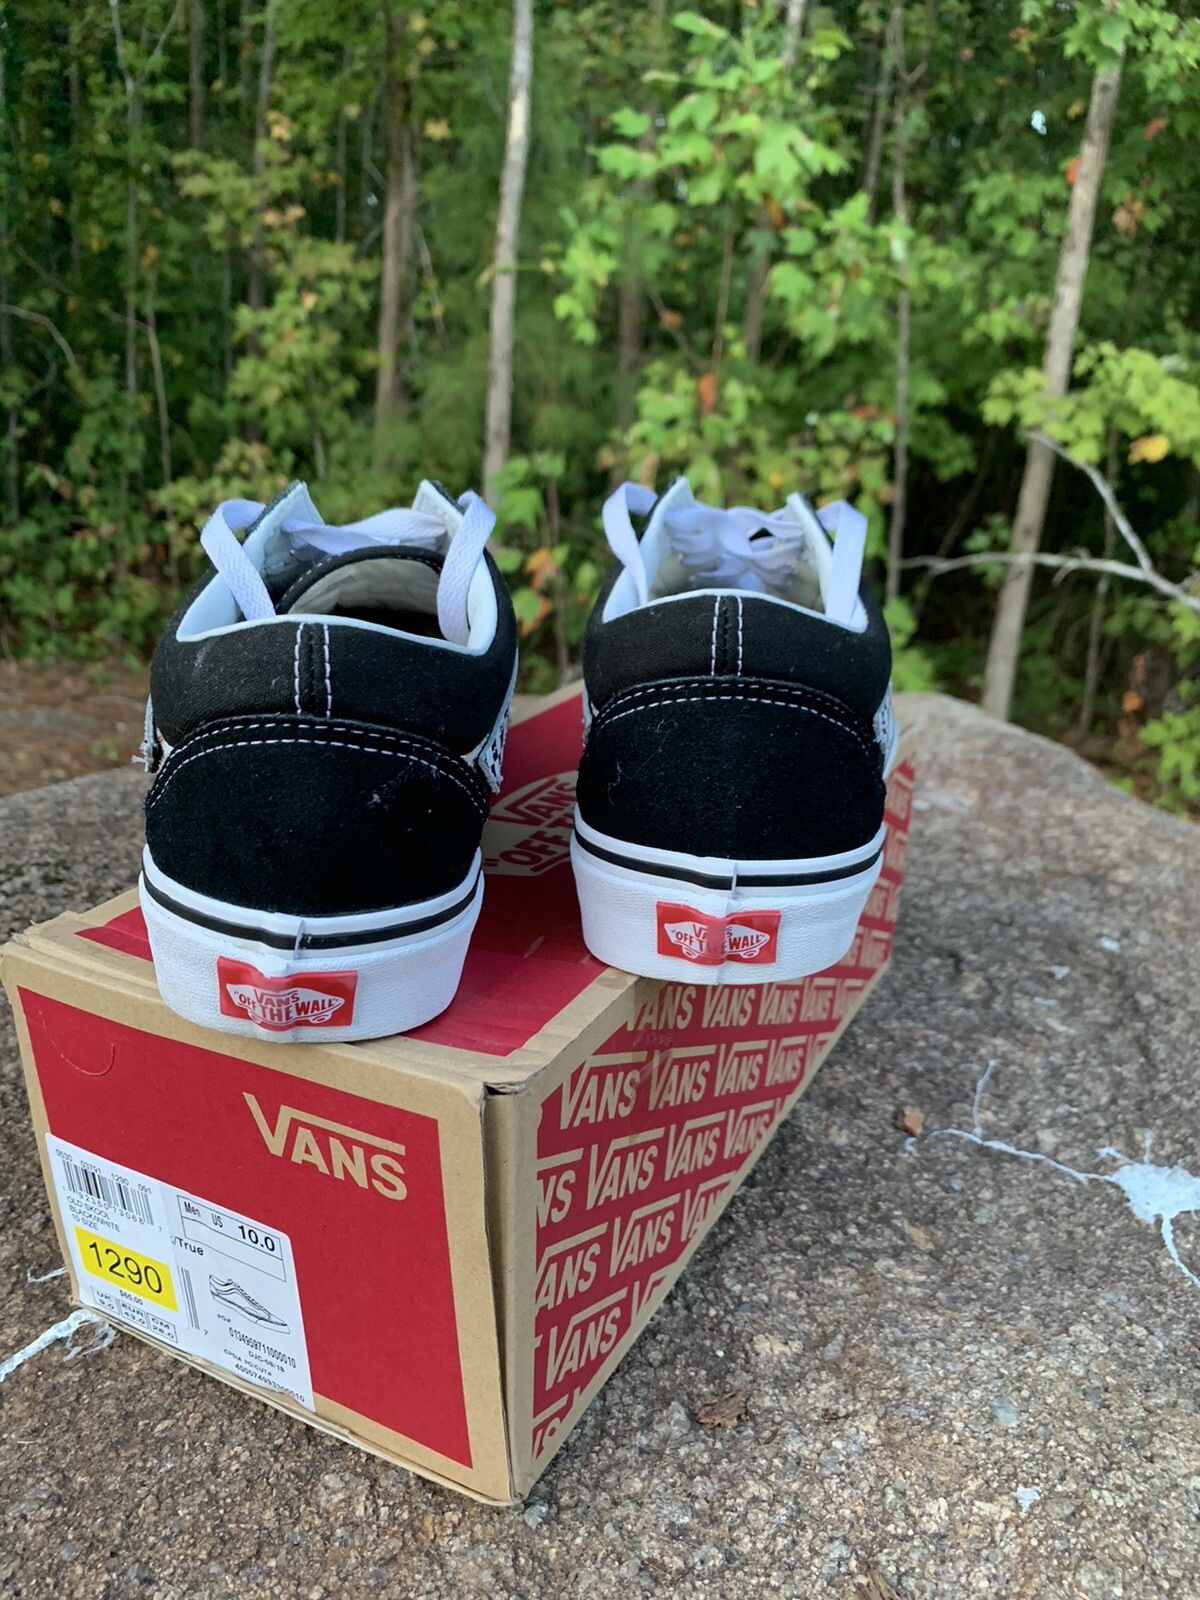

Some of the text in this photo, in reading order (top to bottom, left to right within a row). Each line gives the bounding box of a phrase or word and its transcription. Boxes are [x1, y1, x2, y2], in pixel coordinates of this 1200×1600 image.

[692, 924, 733, 940] VAS
[254, 989, 300, 1008] VANS
[260, 1004, 294, 1022] THE
[702, 984, 756, 1028] VANS
[560, 1051, 648, 1130] VANS
[648, 1044, 716, 1111] VANS
[714, 1039, 769, 1097] VANS
[765, 1034, 809, 1087] VANS
[242, 1092, 408, 1200] VANS
[586, 1127, 665, 1210] VANS
[664, 1111, 726, 1181] VANS
[722, 1099, 775, 1159] VANS
[67, 1195, 110, 1220] OLD SKOOL
[81, 1218, 99, 1231] SIZE
[184, 1201, 276, 1253] Men US 10.0
[609, 1193, 680, 1277] VANS
[89, 1241, 162, 1294] 1290
[545, 1287, 629, 1391] VANS
